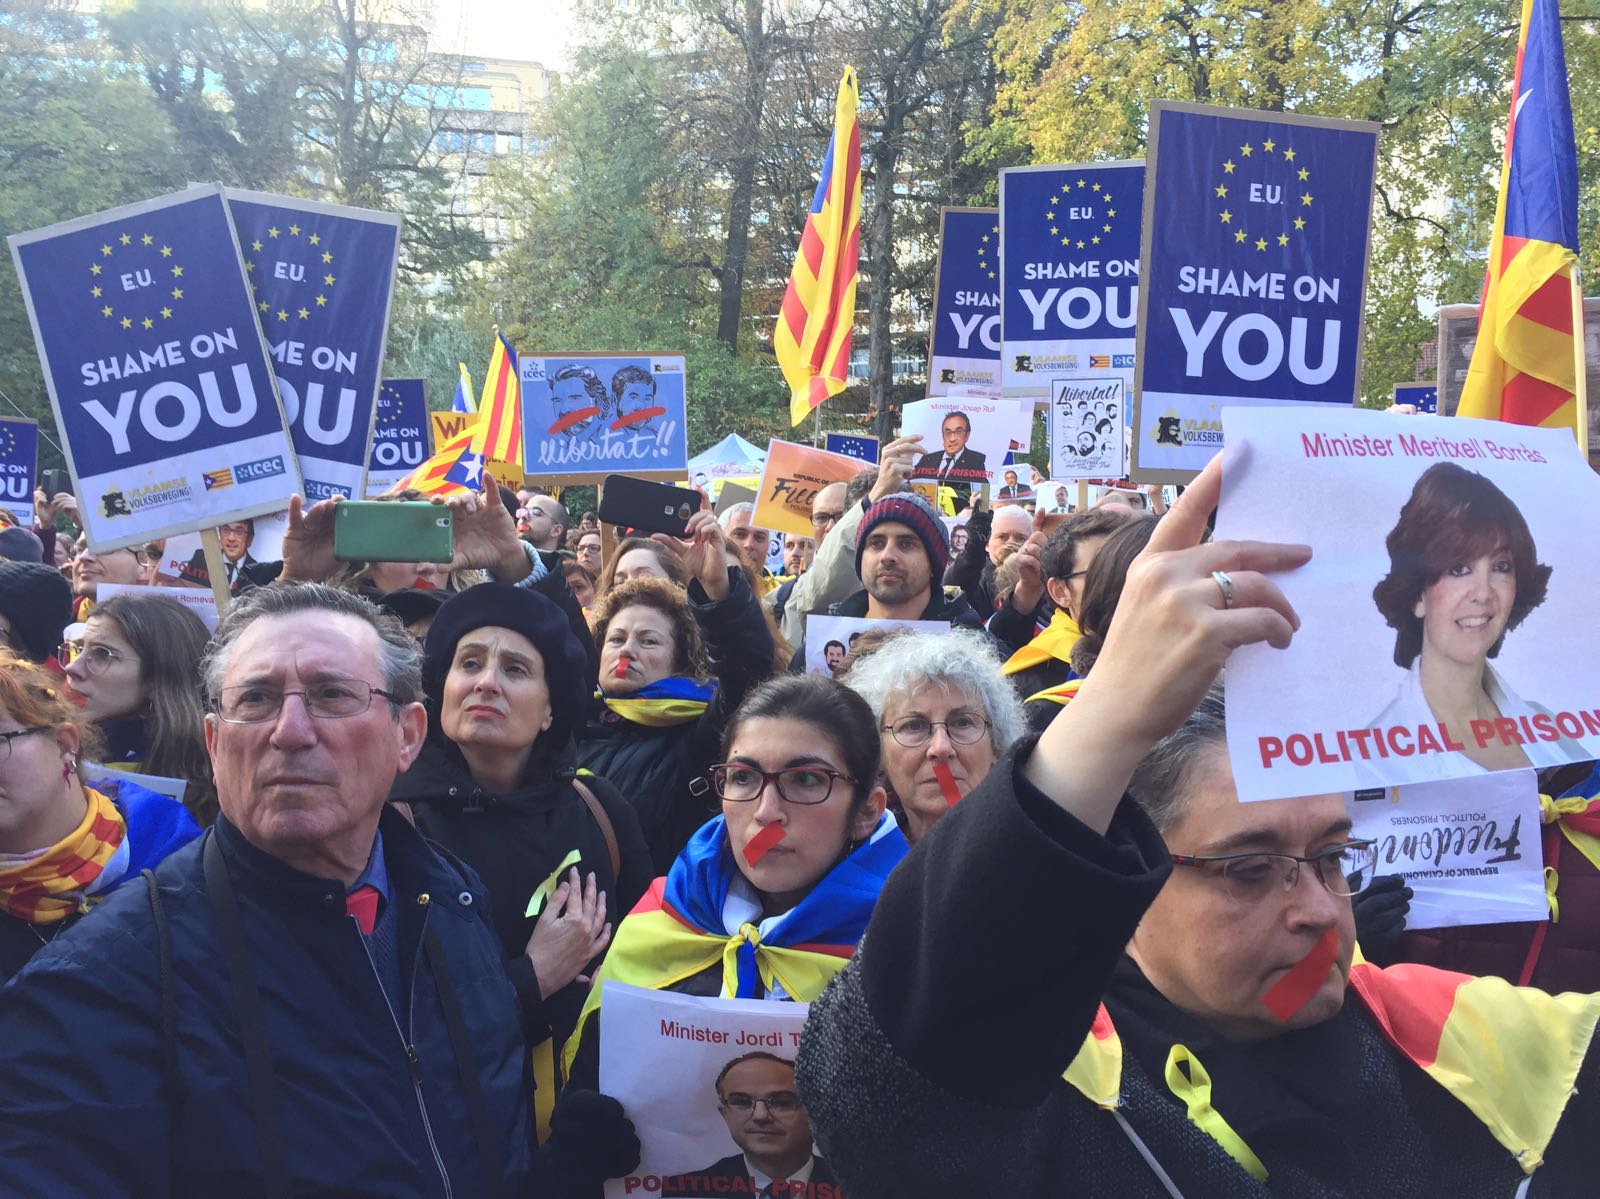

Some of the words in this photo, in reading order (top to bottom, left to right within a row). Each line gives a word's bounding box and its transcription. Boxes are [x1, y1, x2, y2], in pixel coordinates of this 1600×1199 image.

[1249, 183, 1283, 205] E.U.
[1069, 207, 1095, 220] E.U.
[121, 269, 156, 291] E.U.
[274, 262, 306, 282] E.U.
[1024, 261, 1100, 280] SHAME
[1105, 259, 1139, 277] ON
[1178, 266, 1286, 300] SHAME
[1293, 275, 1340, 304] ON
[1018, 286, 1138, 331] YOU
[81, 340, 186, 386] SHAME
[190, 328, 238, 359] ON
[1168, 307, 1341, 385] YOU
[312, 347, 357, 375] ON
[81, 363, 258, 455] YOU
[400, 428, 419, 437] ON
[1300, 432, 1393, 458] Minister
[1398, 434, 1488, 459] Meritxell
[9, 465, 27, 473] ON
[947, 468, 994, 478] PRISONER
[769, 477, 818, 506] Free
[181, 595, 215, 604] Romeva
[1258, 722, 1466, 768] POLITICAL
[1470, 709, 1600, 749] PRISON
[1391, 815, 1438, 826] PRISONERS
[1440, 813, 1486, 822] POLITICAL
[1380, 814, 1521, 866] Freedom
[1445, 869, 1456, 877] OF
[1456, 866, 1499, 876] REPUBLIC
[660, 1019, 729, 1044] Minister
[736, 1031, 783, 1047] Jordi
[624, 1174, 761, 1195] POLITICAL
